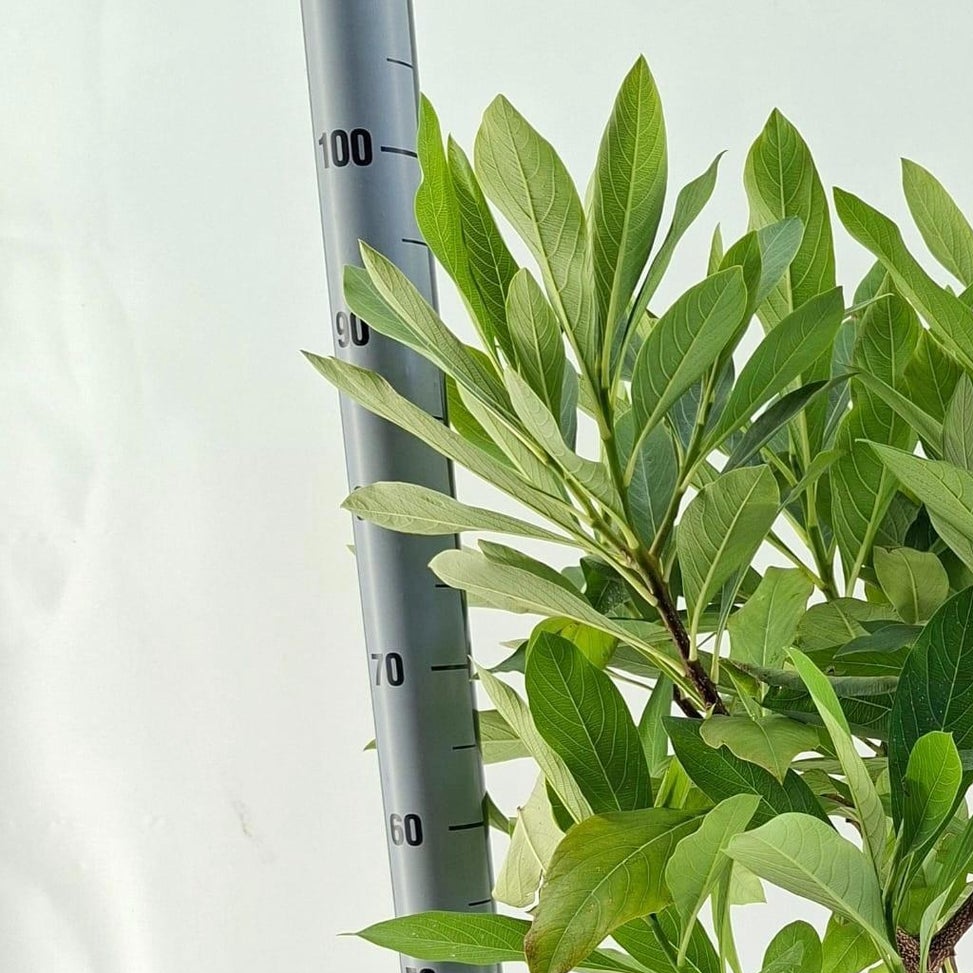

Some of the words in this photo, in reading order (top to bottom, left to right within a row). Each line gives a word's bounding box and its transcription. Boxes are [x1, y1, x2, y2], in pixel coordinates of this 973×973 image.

[318, 128, 372, 168] 100
[336, 310, 370, 347] 90
[371, 652, 404, 687] 70
[389, 813, 423, 847] 60
